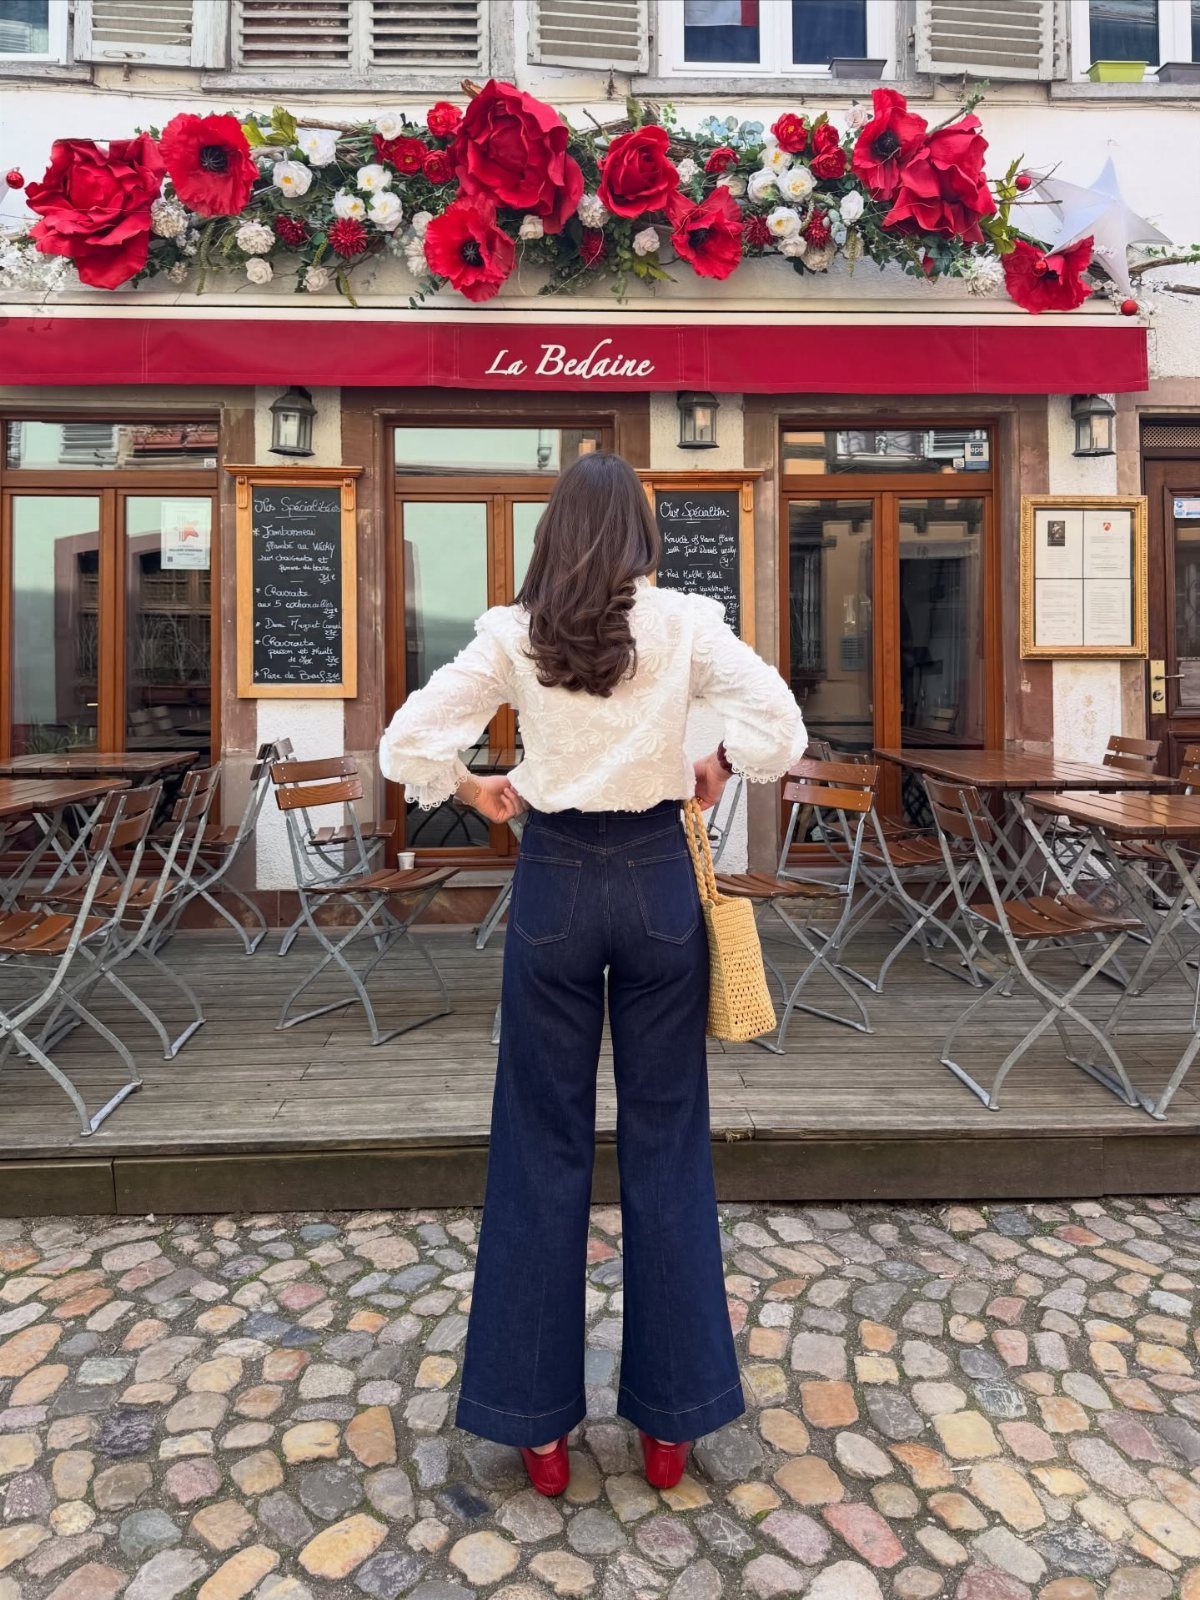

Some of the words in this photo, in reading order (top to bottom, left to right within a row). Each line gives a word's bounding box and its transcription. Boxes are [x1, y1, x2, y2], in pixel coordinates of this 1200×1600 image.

[485, 349, 527, 375] La
[535, 338, 655, 379] Bedaine
[660, 501, 680, 518] Our
[297, 542, 309, 550] au
[665, 569, 679, 579] Red
[273, 600, 282, 608] 5
[284, 670, 296, 680] de
